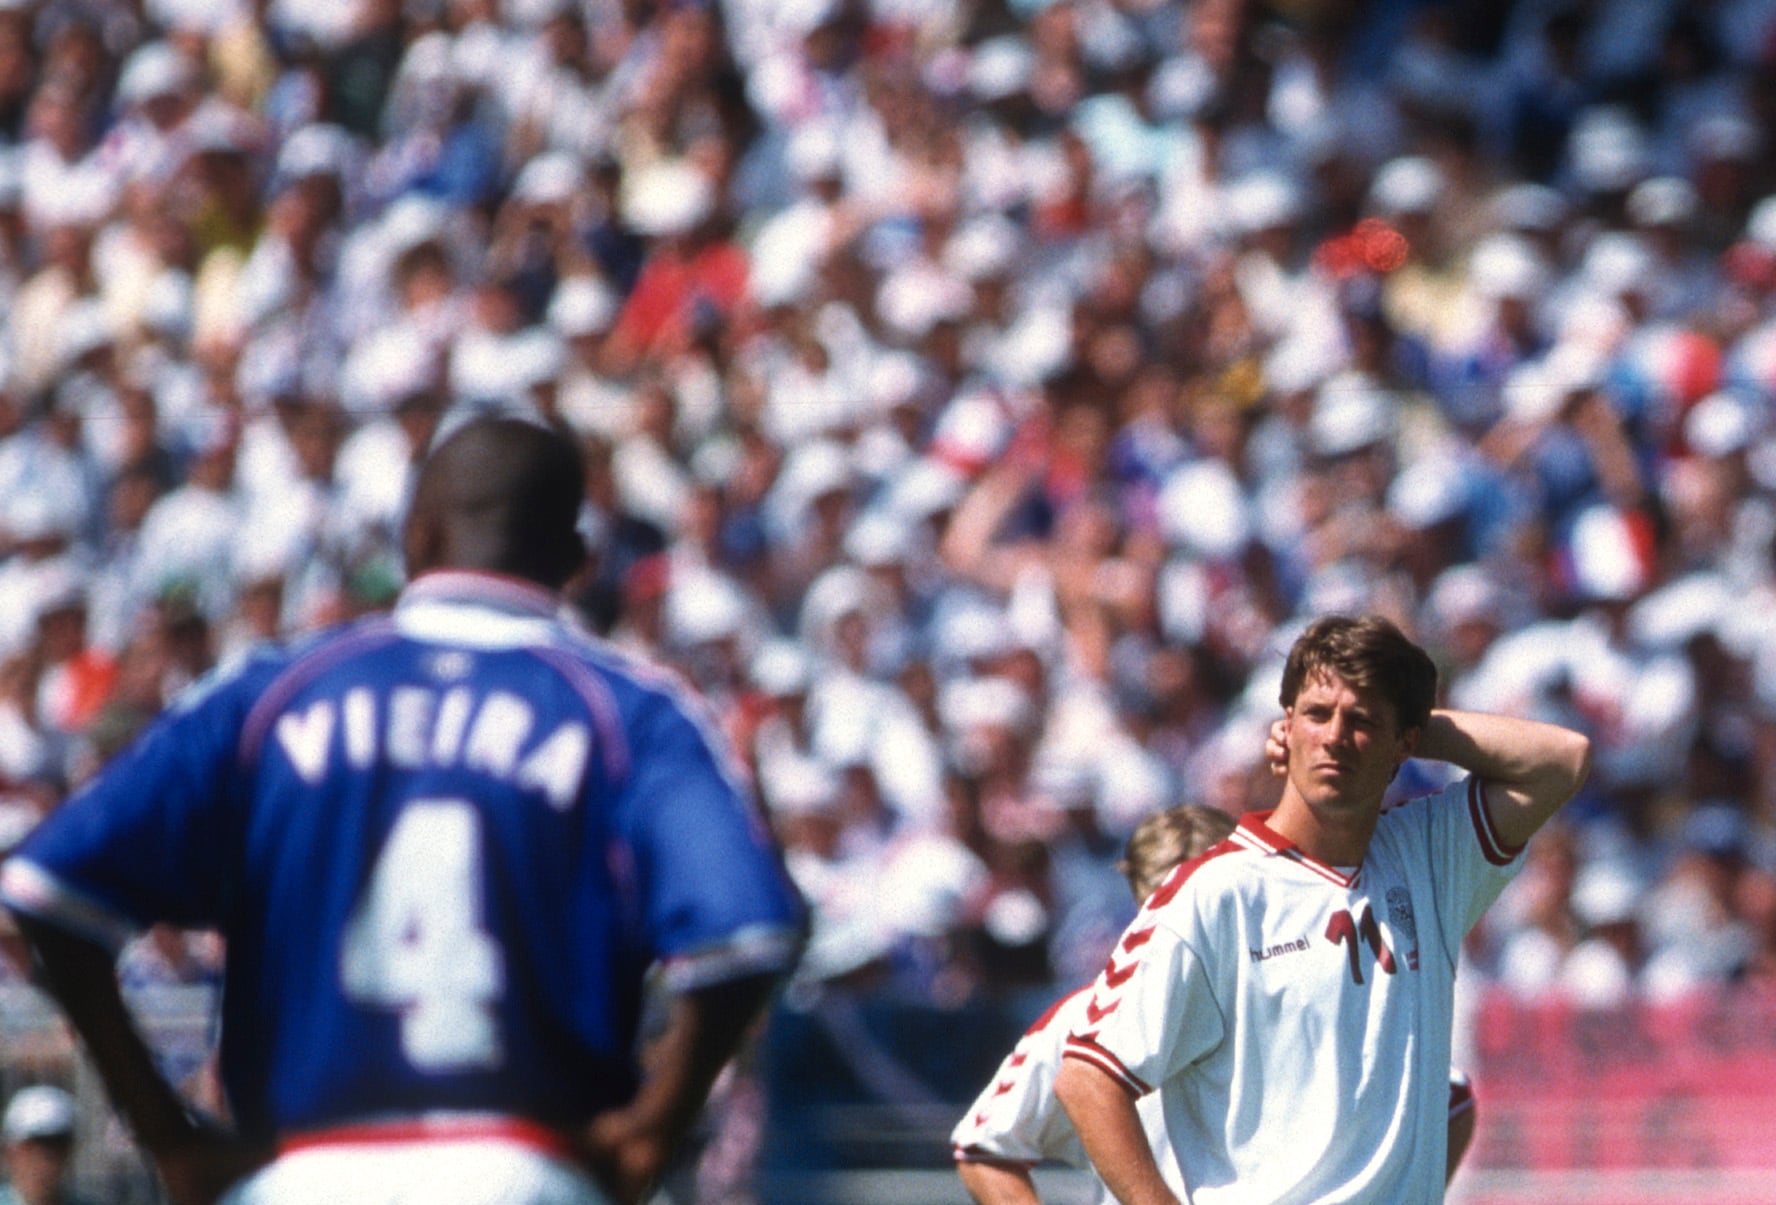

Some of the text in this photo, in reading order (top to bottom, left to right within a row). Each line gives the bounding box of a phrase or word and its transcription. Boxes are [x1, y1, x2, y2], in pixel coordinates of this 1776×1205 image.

[276, 684, 592, 812] VIEIRA
[340, 798, 506, 1074] 4
[1249, 933, 1312, 964] hummel
[1324, 904, 1397, 985] 11
